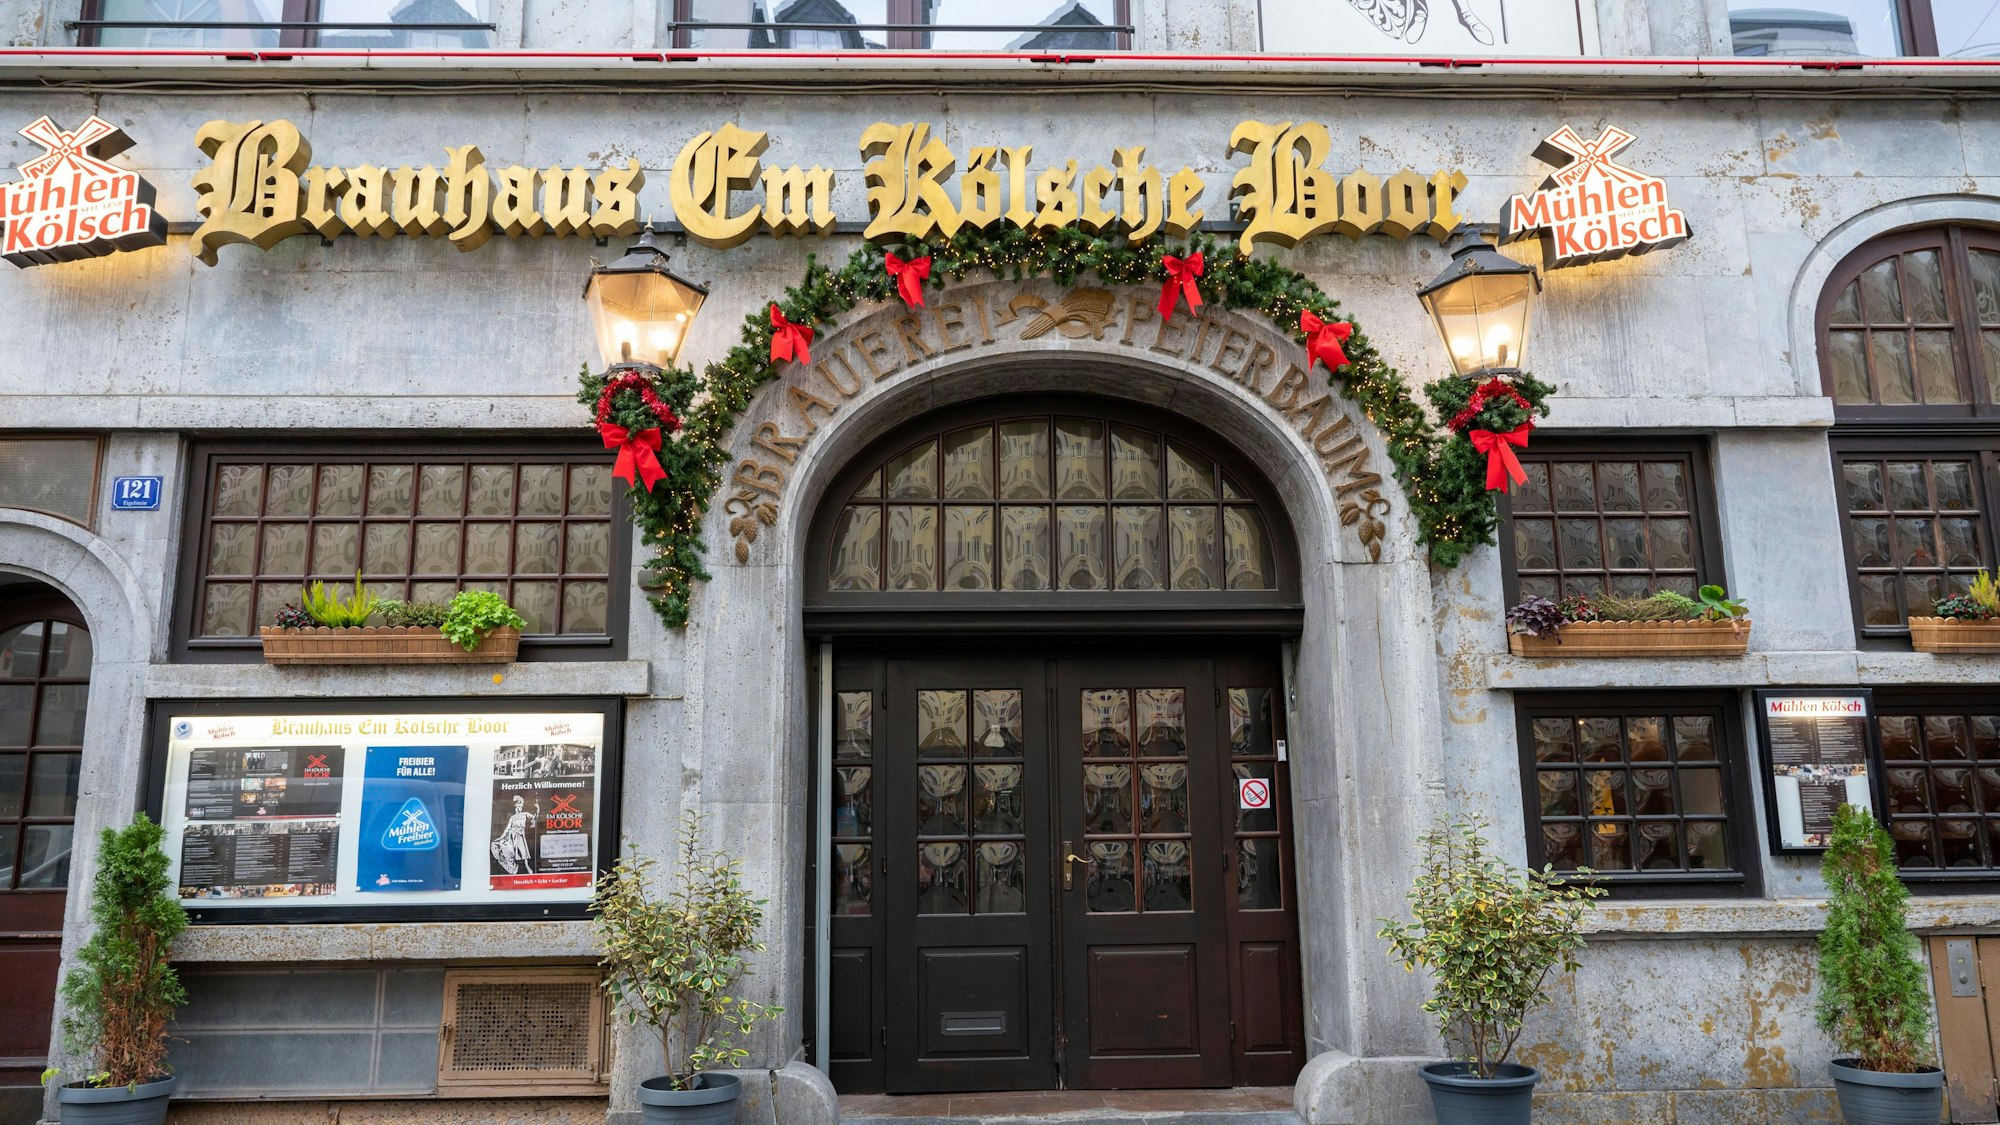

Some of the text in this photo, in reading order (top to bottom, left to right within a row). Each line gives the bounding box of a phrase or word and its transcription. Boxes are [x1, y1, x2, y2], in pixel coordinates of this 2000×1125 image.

[190, 119, 1469, 263] Brauhaus Em Kölsche Boor
[1513, 179, 1664, 231] Mühlen
[6, 198, 147, 251] Kölsch
[1556, 204, 1683, 256] Kölsch
[734, 296, 996, 497] BRAUEREI
[122, 480, 151, 498] 121
[1771, 700, 1861, 712] Mühlen Kölsch
[272, 717, 510, 737] Brauhaus Em Kölsche Boor
[399, 757, 434, 766] FREIBIER
[396, 766, 436, 776] FÜR ALLE!
[501, 781, 585, 790] Herzlich Willkommen!
[388, 822, 429, 838] Mühlen
[546, 819, 583, 829] BOOR
[398, 831, 433, 844] Freibier
